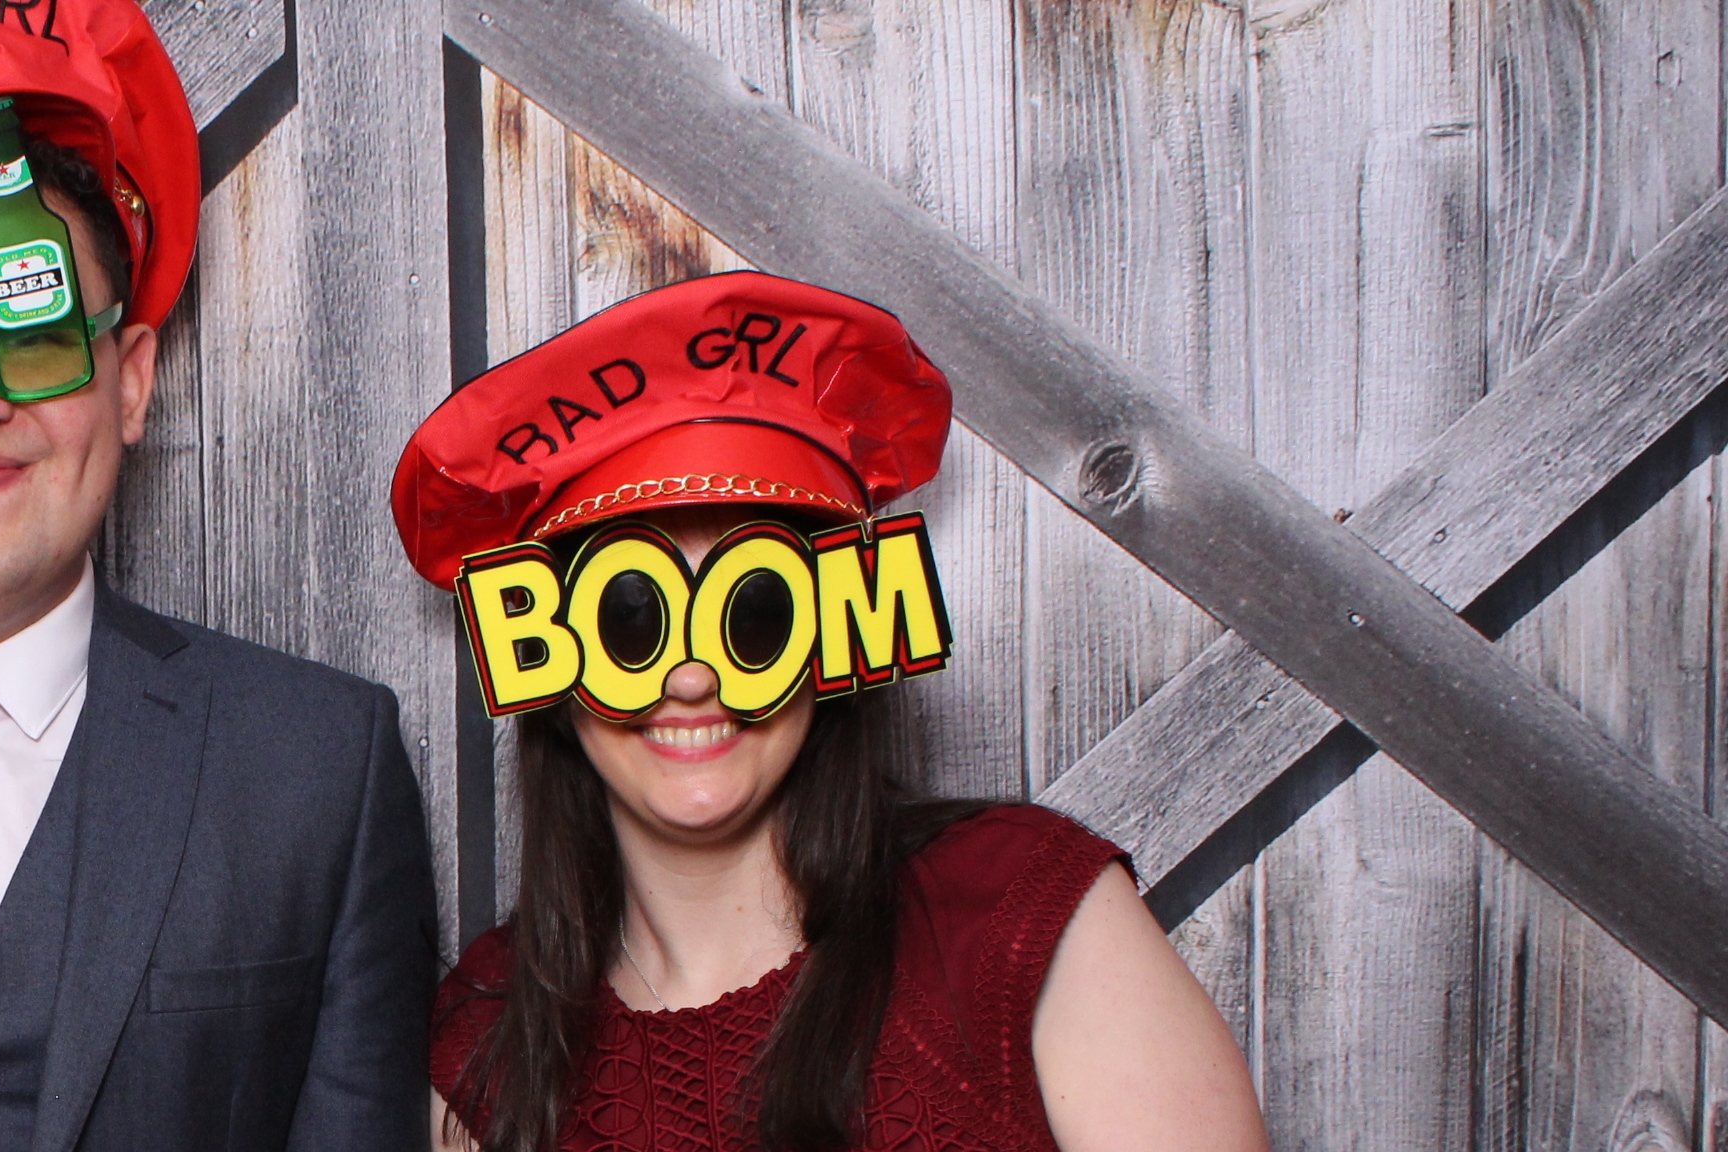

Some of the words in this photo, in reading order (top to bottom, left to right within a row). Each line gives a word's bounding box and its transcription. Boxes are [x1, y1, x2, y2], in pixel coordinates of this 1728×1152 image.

[496, 358, 647, 465] BAD
[686, 312, 808, 388] GRL
[454, 510, 953, 722] BOOM
